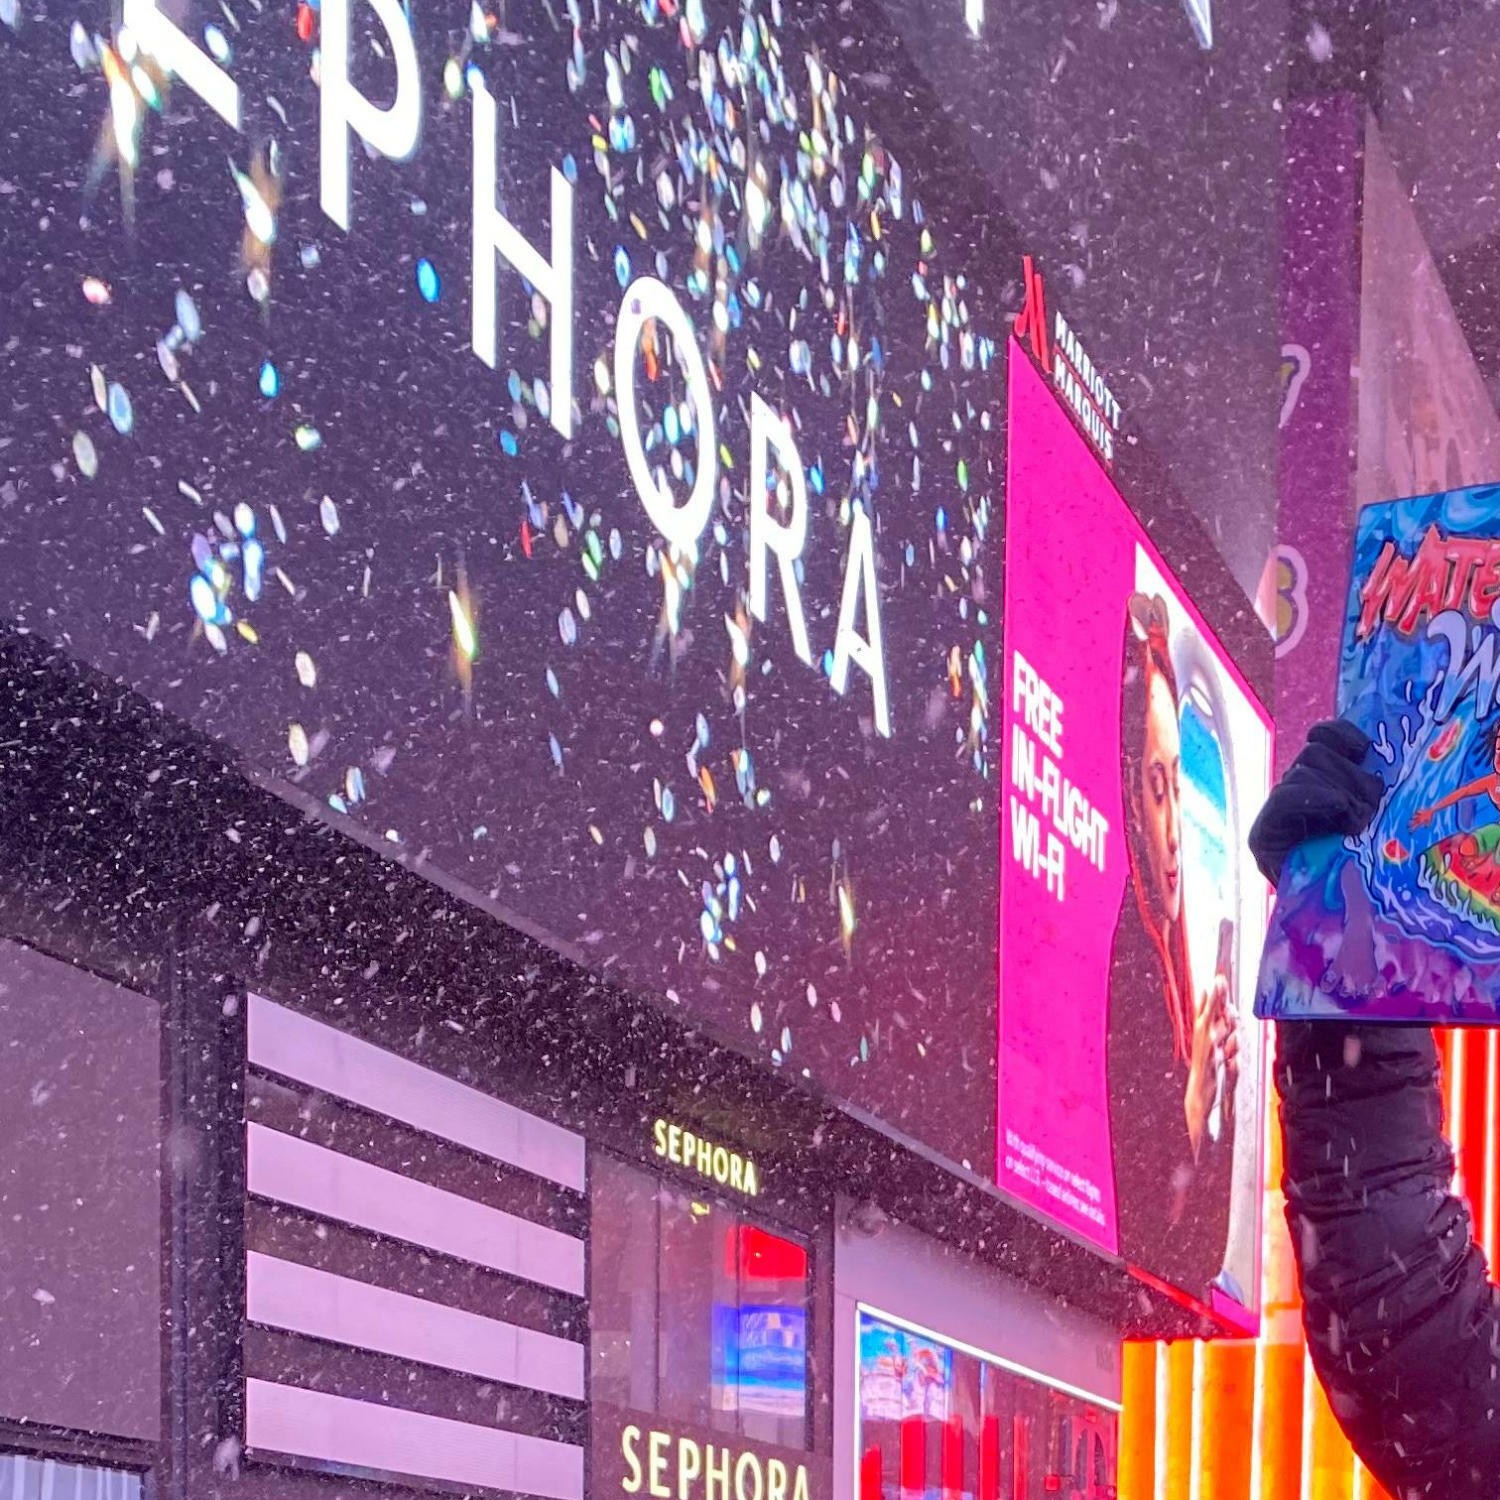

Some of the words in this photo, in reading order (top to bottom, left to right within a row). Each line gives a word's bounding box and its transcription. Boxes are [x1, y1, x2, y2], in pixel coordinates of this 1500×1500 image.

[1054, 353, 1114, 460] MARQUIS
[1056, 311, 1122, 430] MARRIOTT
[1013, 649, 1064, 760] FREE
[1011, 722, 1110, 873] IN-FLIGHT
[1011, 795, 1065, 902] WI-FI
[653, 1118, 758, 1196] SEPHORA
